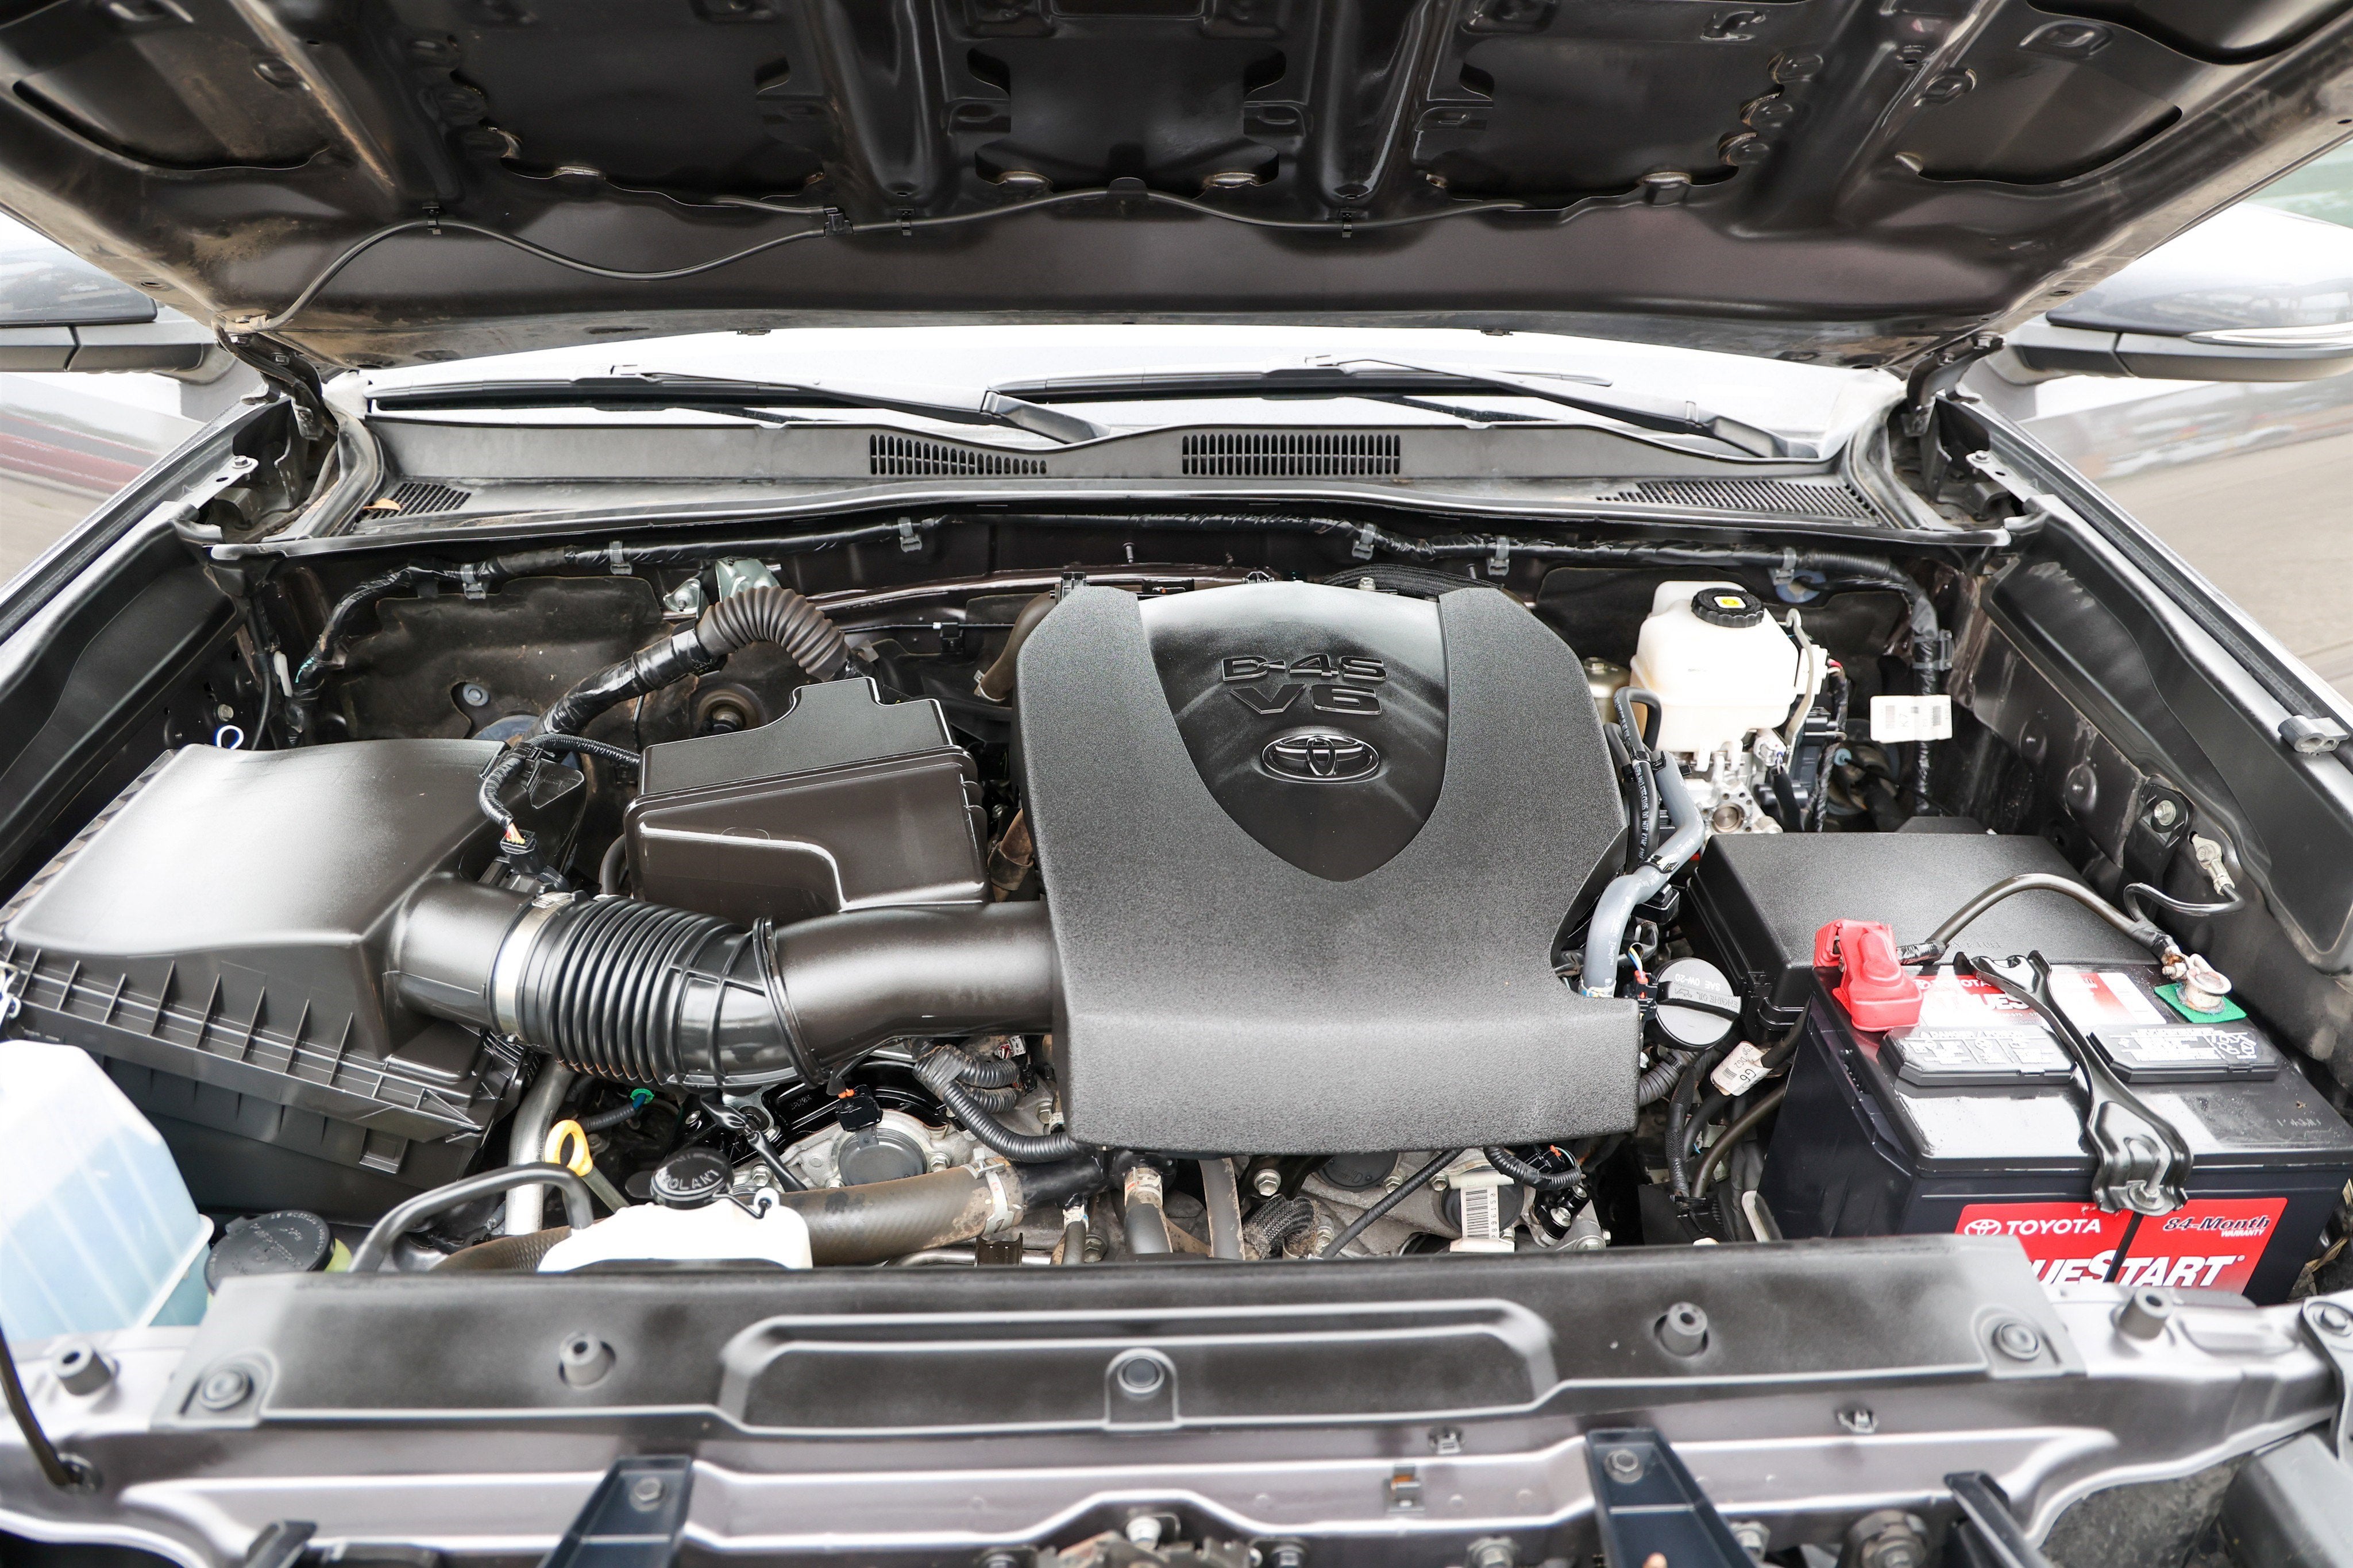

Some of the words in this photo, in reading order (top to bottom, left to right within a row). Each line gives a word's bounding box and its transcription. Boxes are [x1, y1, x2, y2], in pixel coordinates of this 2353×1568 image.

[1221, 654, 1387, 682] D-4S
[1229, 683, 1382, 716] V6
[1675, 973, 1701, 986] 0W-20
[1704, 980, 1721, 992] SAE
[1696, 991, 1708, 1002] OIL
[1710, 994, 1738, 1009] ENGINE
[1739, 1068, 1757, 1083] G6
[2006, 1218, 2101, 1235] TOYOTA
[2163, 1215, 2271, 1231] 84-Month
[2221, 1229, 2266, 1238] WARRANTY
[2031, 1249, 2238, 1287] UESTART
